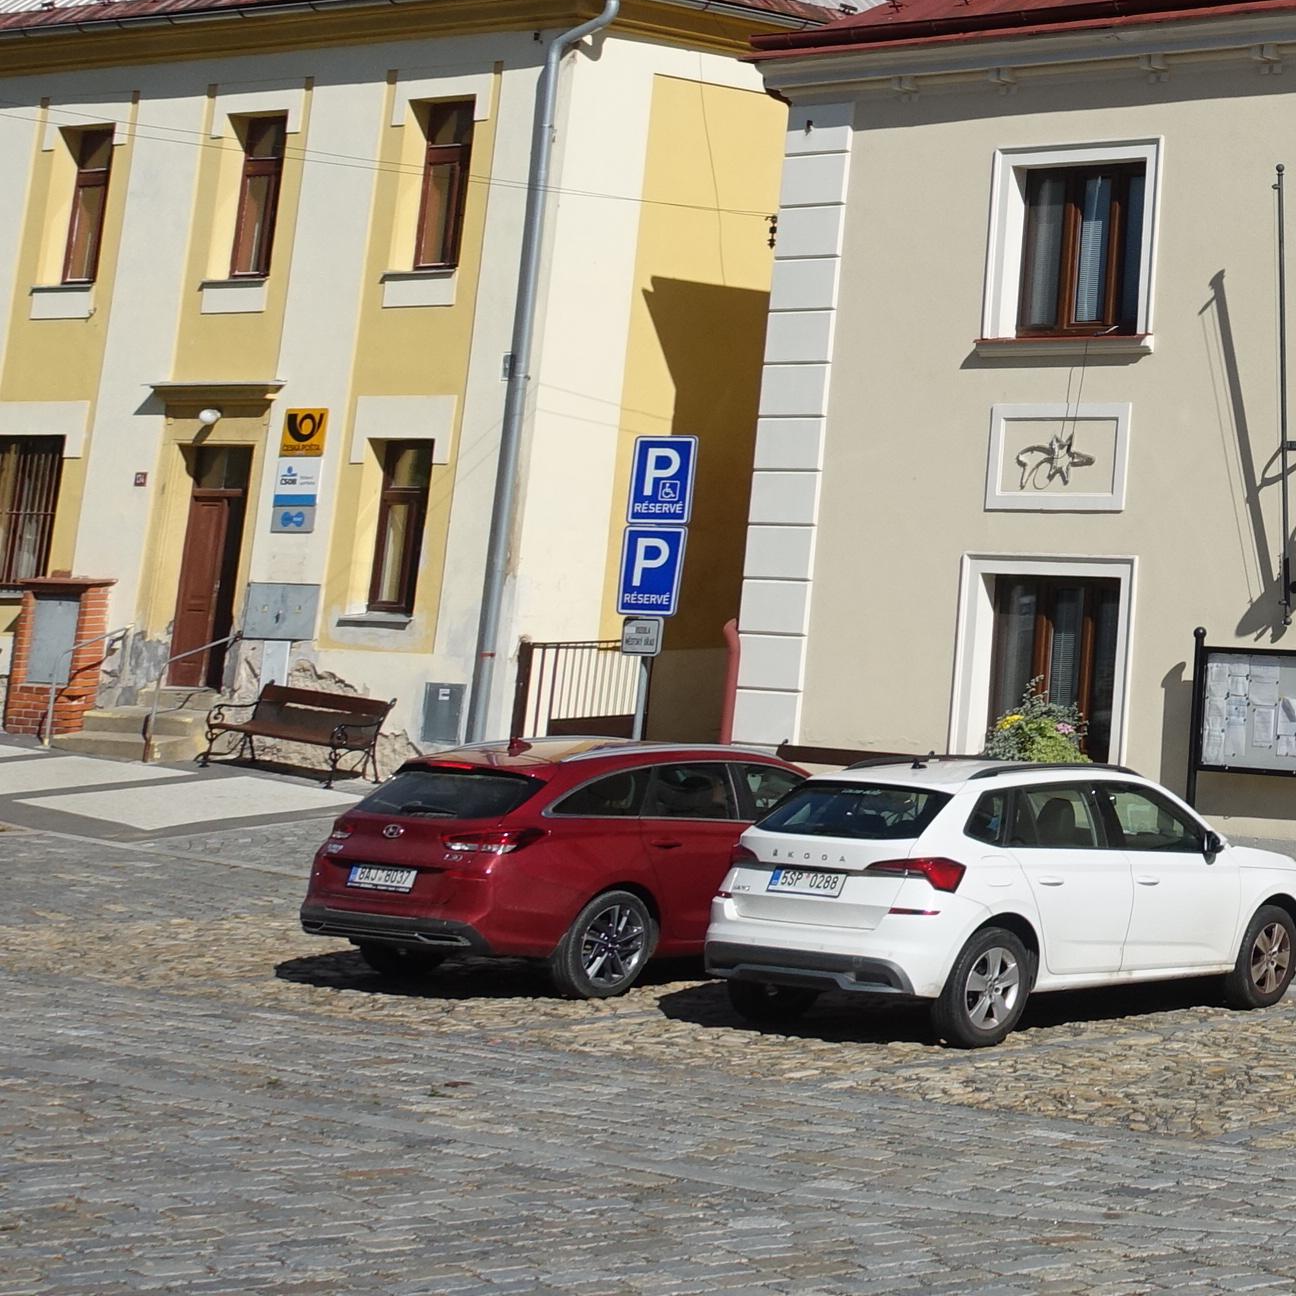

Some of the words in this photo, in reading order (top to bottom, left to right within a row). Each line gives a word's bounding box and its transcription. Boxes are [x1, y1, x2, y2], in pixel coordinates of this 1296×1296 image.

[643, 447, 681, 496] P
[634, 501, 683, 513] RÉSERVÉ
[632, 538, 670, 586] P
[624, 592, 670, 604] RÉSERVÉ
[772, 848, 846, 862] ŠKODA
[780, 870, 803, 887] 5SP
[809, 873, 839, 890] 0288
